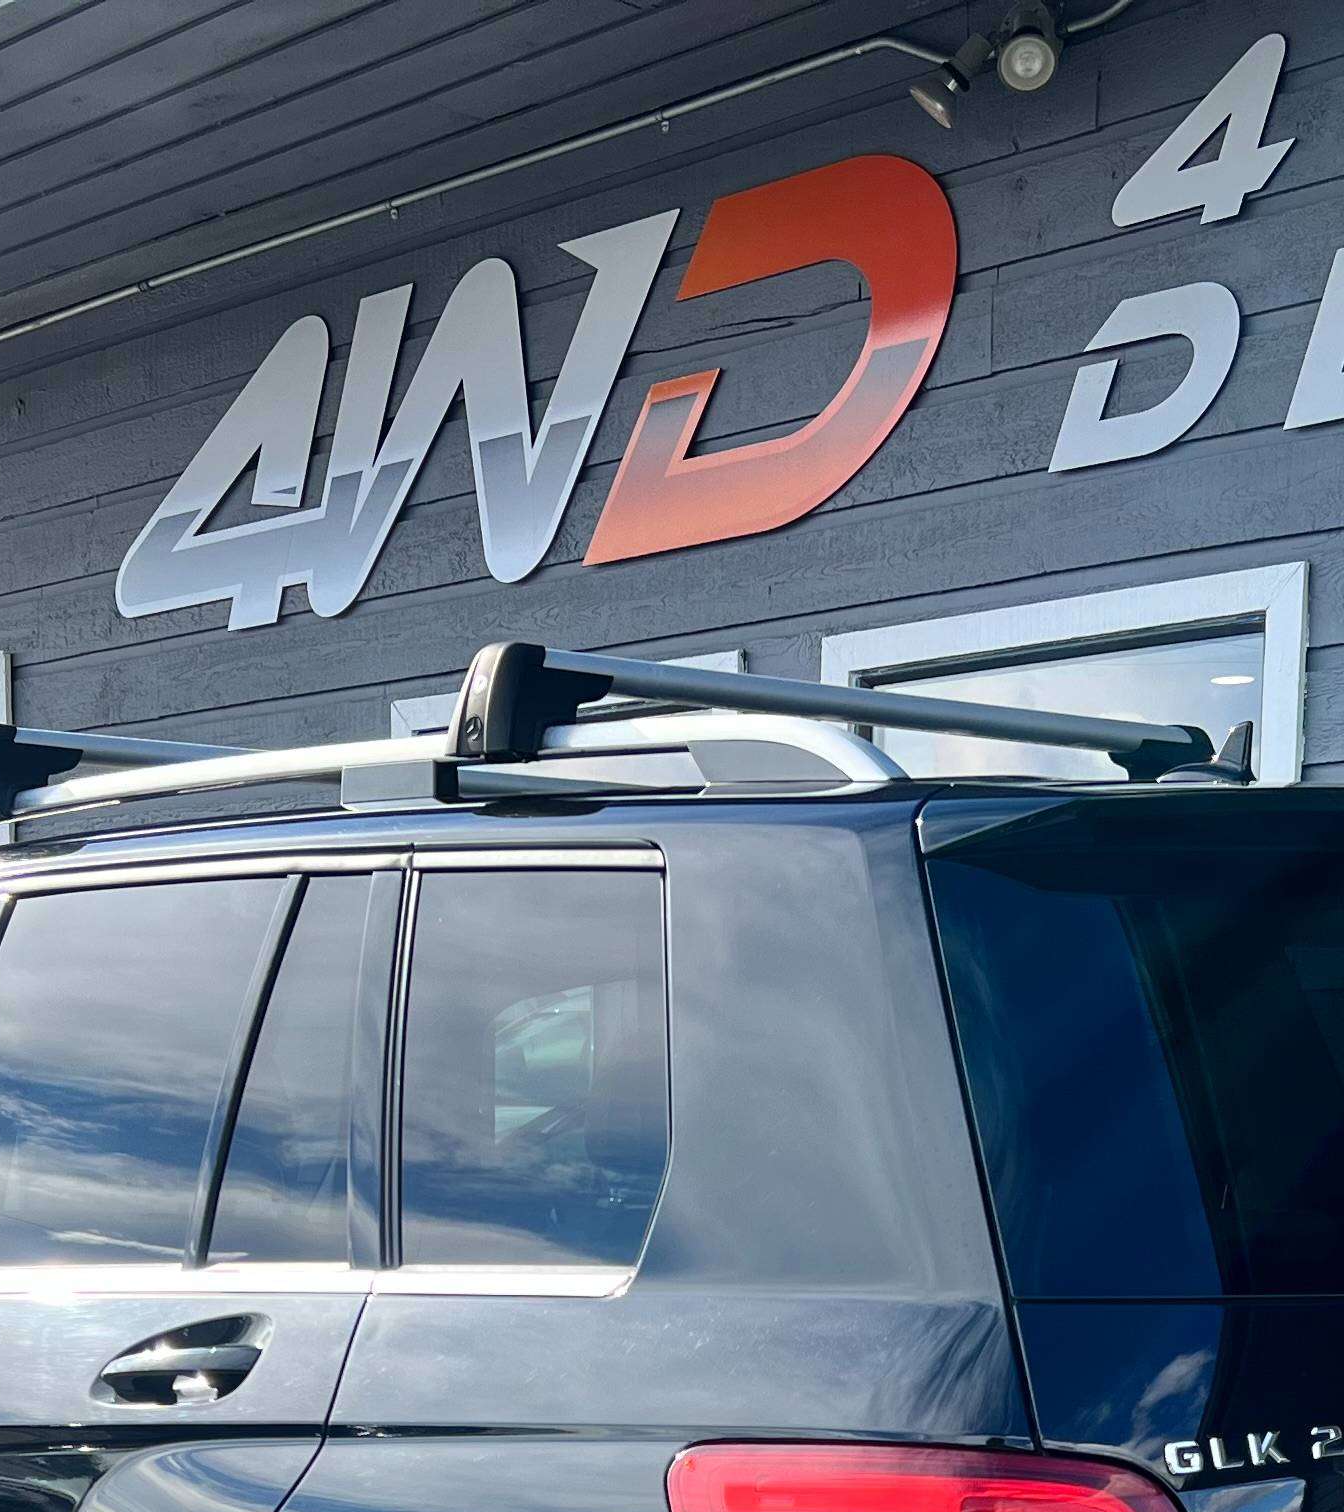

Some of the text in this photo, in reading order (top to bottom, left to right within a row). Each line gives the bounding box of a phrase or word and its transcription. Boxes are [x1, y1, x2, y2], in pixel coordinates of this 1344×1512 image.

[1111, 33, 1294, 226] 4
[115, 154, 957, 632] 4WD
[1164, 1431, 1291, 1475] GLK
